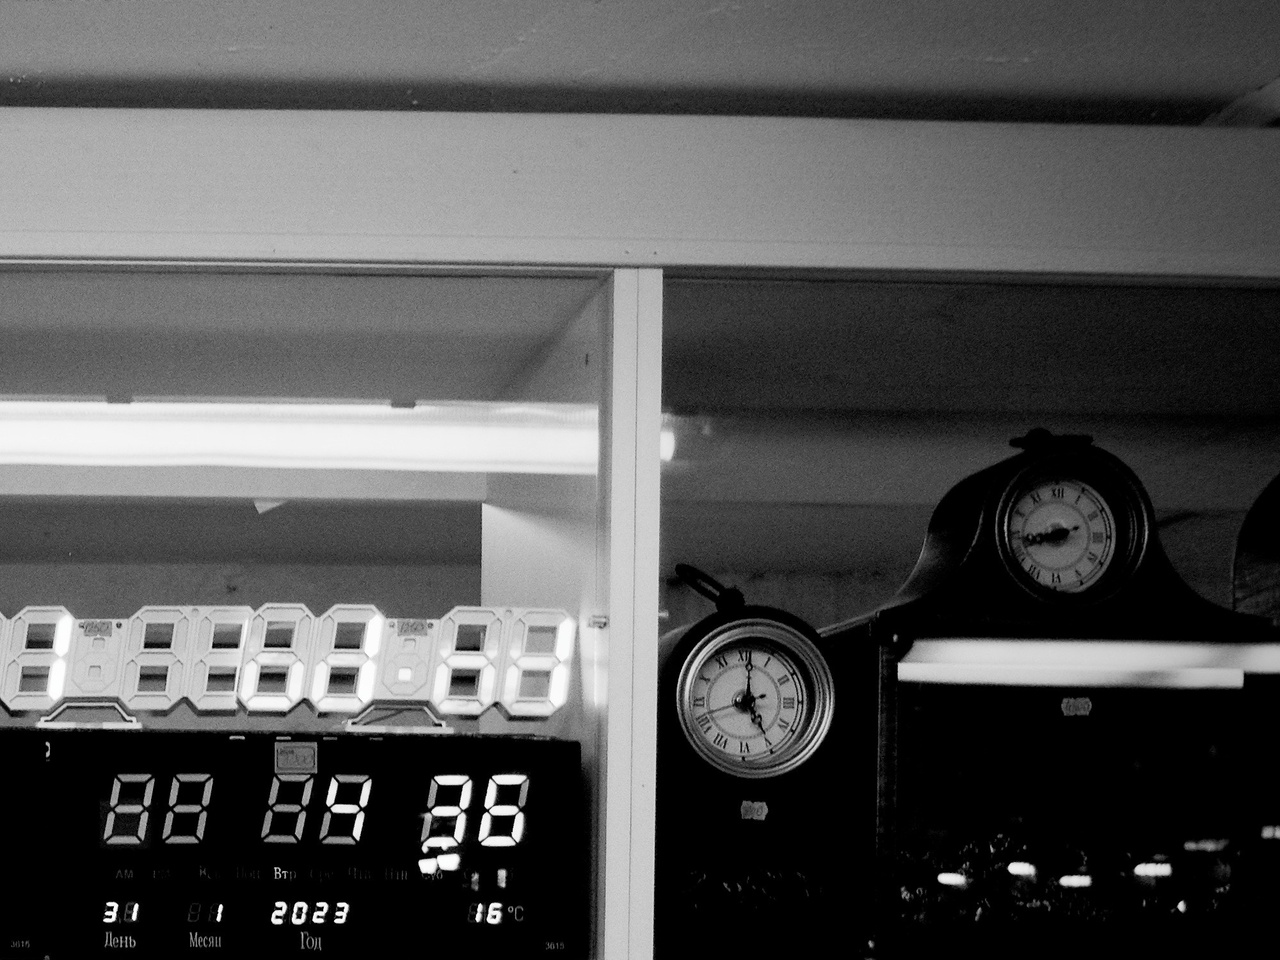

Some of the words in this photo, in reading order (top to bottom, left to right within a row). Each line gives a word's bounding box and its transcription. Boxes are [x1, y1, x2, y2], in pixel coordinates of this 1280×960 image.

[103, 902, 138, 923] 31
[271, 901, 350, 924] 2023
[104, 932, 137, 949] День
[189, 932, 222, 949] Месяц
[300, 932, 323, 951] Год
